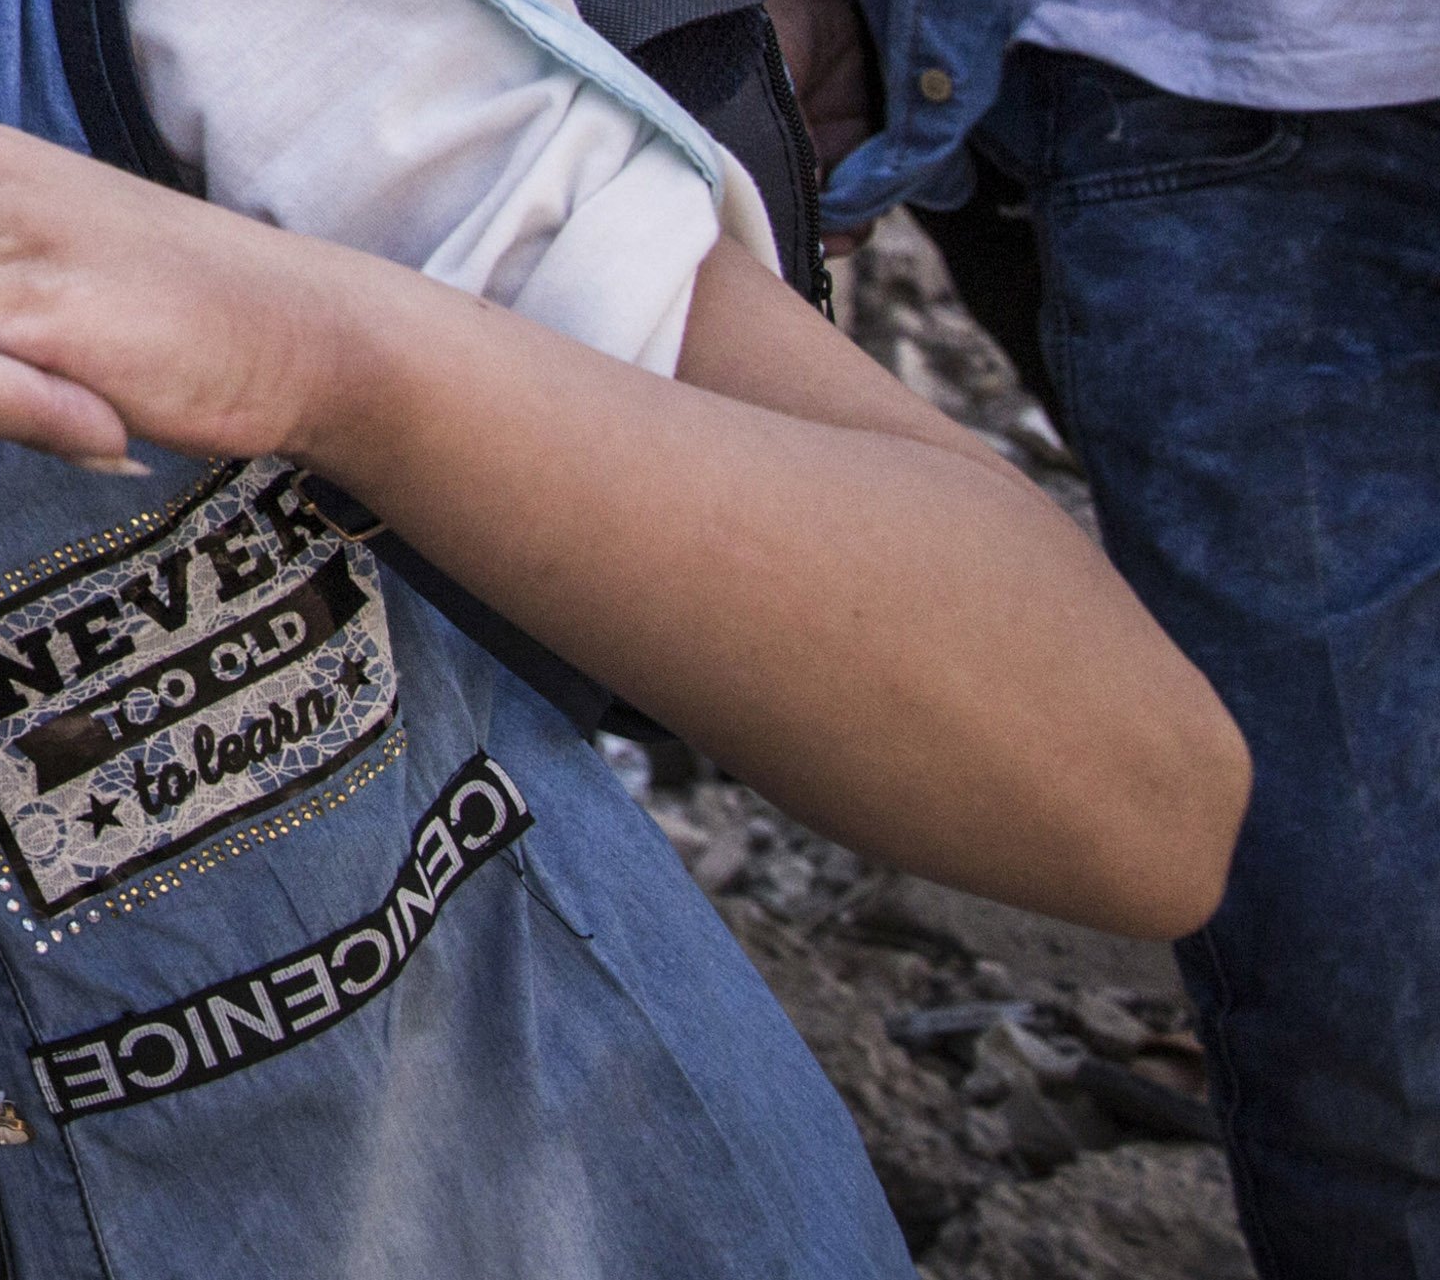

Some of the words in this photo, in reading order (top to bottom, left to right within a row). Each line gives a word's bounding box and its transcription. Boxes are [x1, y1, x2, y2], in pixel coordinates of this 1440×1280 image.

[90, 667, 196, 741] TOO
[208, 610, 308, 684] OLD
[132, 757, 197, 817] to
[192, 687, 338, 786] learn
